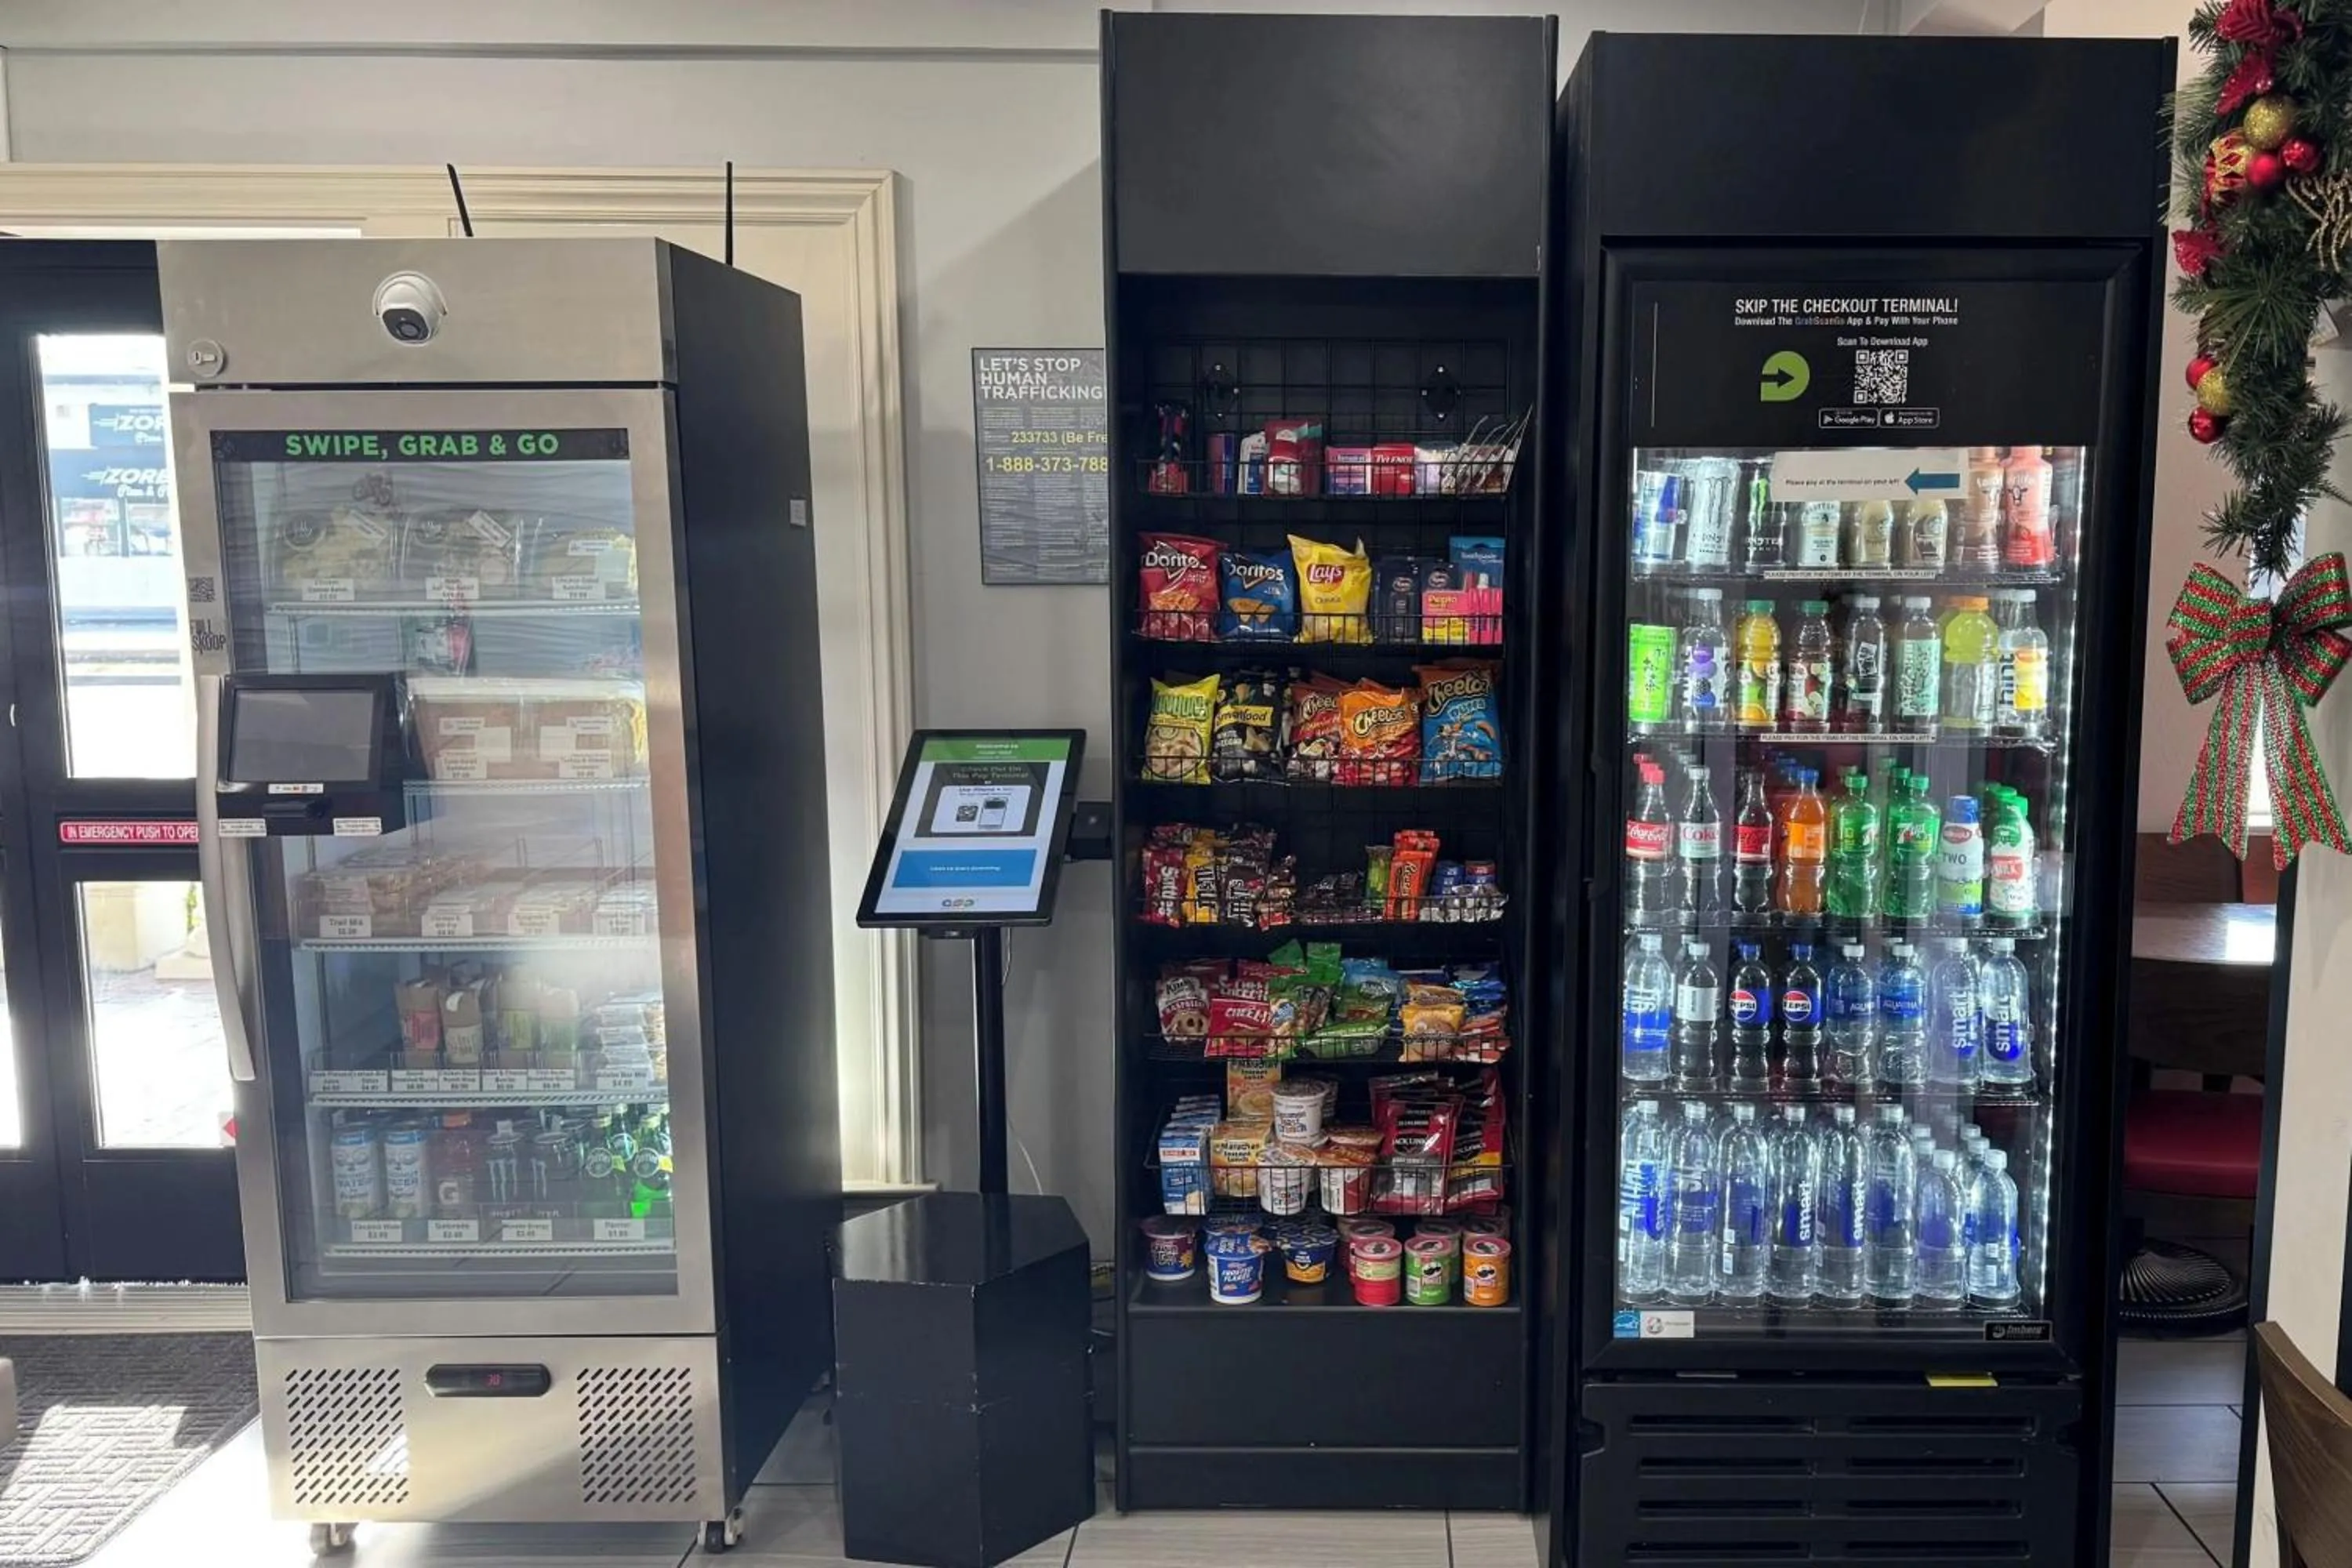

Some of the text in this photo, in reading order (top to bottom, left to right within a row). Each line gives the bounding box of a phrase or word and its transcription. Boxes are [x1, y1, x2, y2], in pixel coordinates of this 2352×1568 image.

[1735, 298, 1958, 314] SKIP THE CHECKOUT TERMINAL!
[1735, 317, 1775, 326] Download
[1779, 317, 1793, 325] The
[1847, 317, 1863, 327] App
[1866, 317, 1871, 325] &
[1874, 317, 1889, 327] Pay
[1891, 317, 1910, 325] With
[1912, 317, 1930, 325] Your
[1933, 317, 1958, 326] Phone
[1837, 337, 1928, 347] Scan To Download App
[979, 358, 1081, 372] LET'S STOP
[981, 372, 1047, 386] HUMAN
[981, 385, 1103, 399] TRAFFICKING
[285, 433, 559, 459] SWIPE, GRAB & GO
[1011, 431, 1058, 444] 233733
[1061, 431, 1083, 445] (Be
[1308, 564, 1345, 584] Lay's
[1999, 653, 2014, 706] hint
[1354, 708, 1406, 736] Cheetos
[67, 826, 198, 839] IN EMERGENCY PUSH TO OPE
[1951, 990, 1968, 1049] smart
[1995, 994, 2011, 1053] smart
[1799, 1181, 1813, 1240] smart
